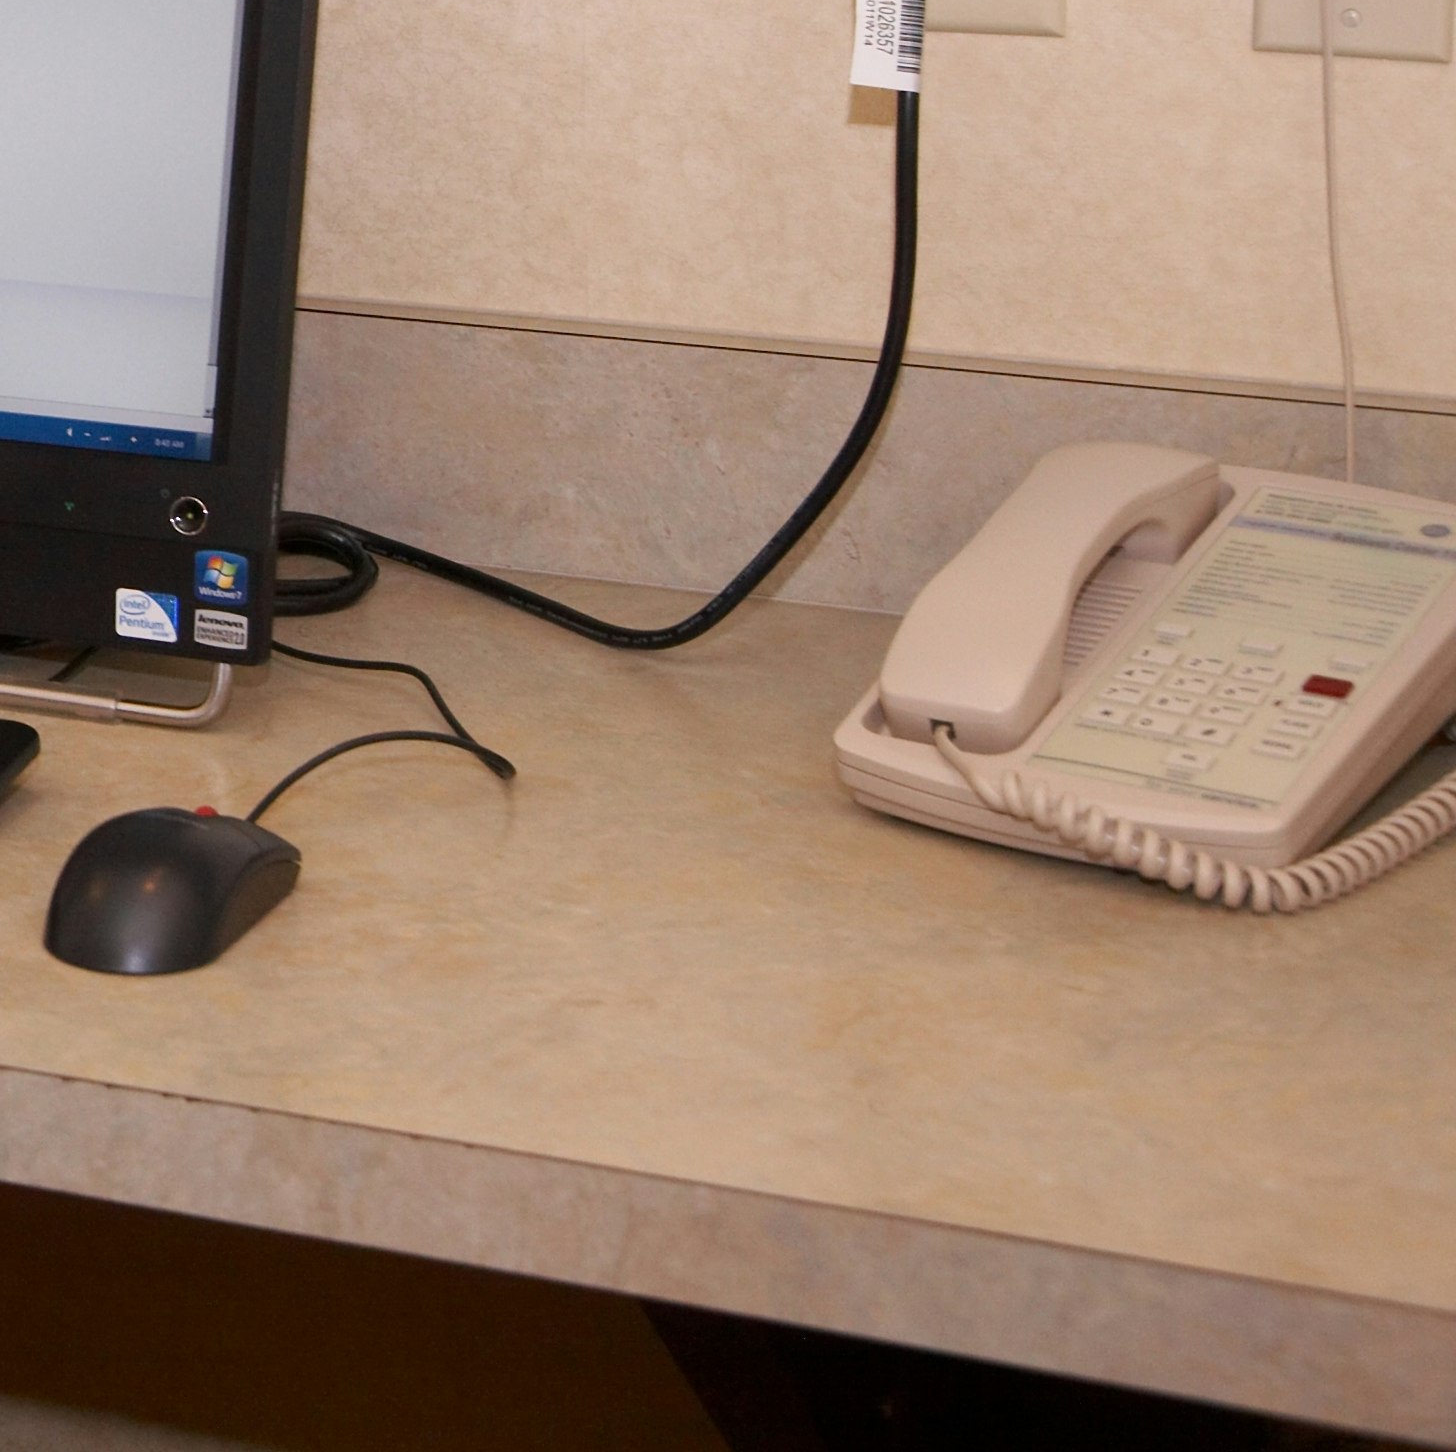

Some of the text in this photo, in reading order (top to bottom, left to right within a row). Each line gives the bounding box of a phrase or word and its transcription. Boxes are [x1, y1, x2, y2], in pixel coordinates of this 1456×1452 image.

[198, 586, 235, 599] Windows
[122, 599, 147, 609] intel
[119, 614, 165, 630] Pentium
[198, 614, 244, 629] lenovo
